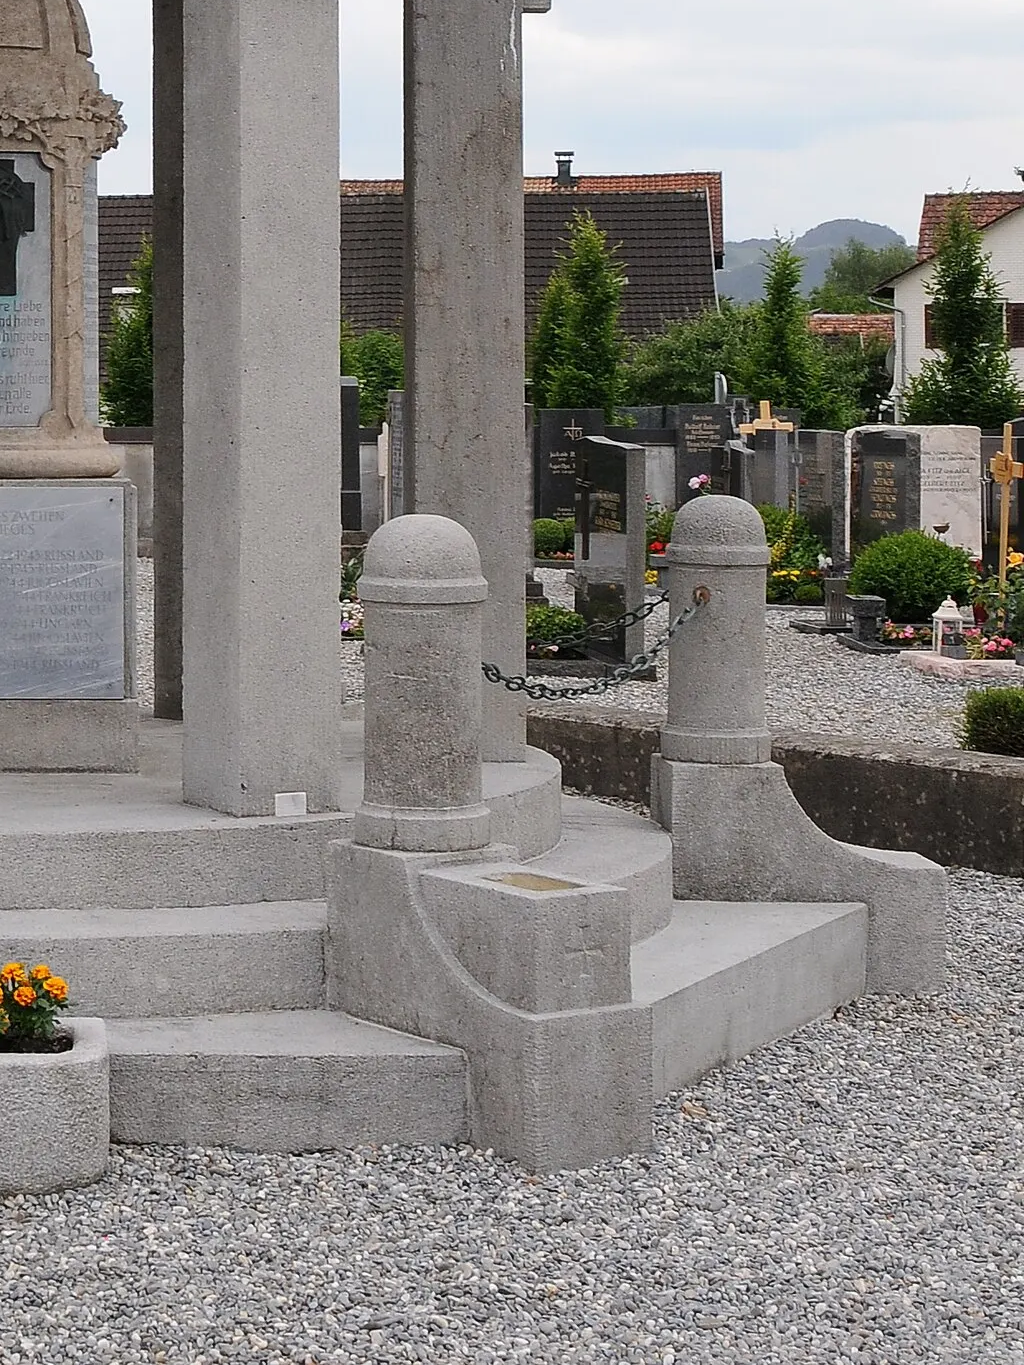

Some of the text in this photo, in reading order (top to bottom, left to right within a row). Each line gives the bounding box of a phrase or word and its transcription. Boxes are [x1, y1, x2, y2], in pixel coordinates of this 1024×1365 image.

[13, 300, 42, 312] Liebe
[13, 315, 46, 327] haben
[2, 330, 50, 344] hingeben
[5, 373, 28, 385] ruht
[12, 387, 32, 399] alle
[10, 511, 64, 522] ZWEITEN
